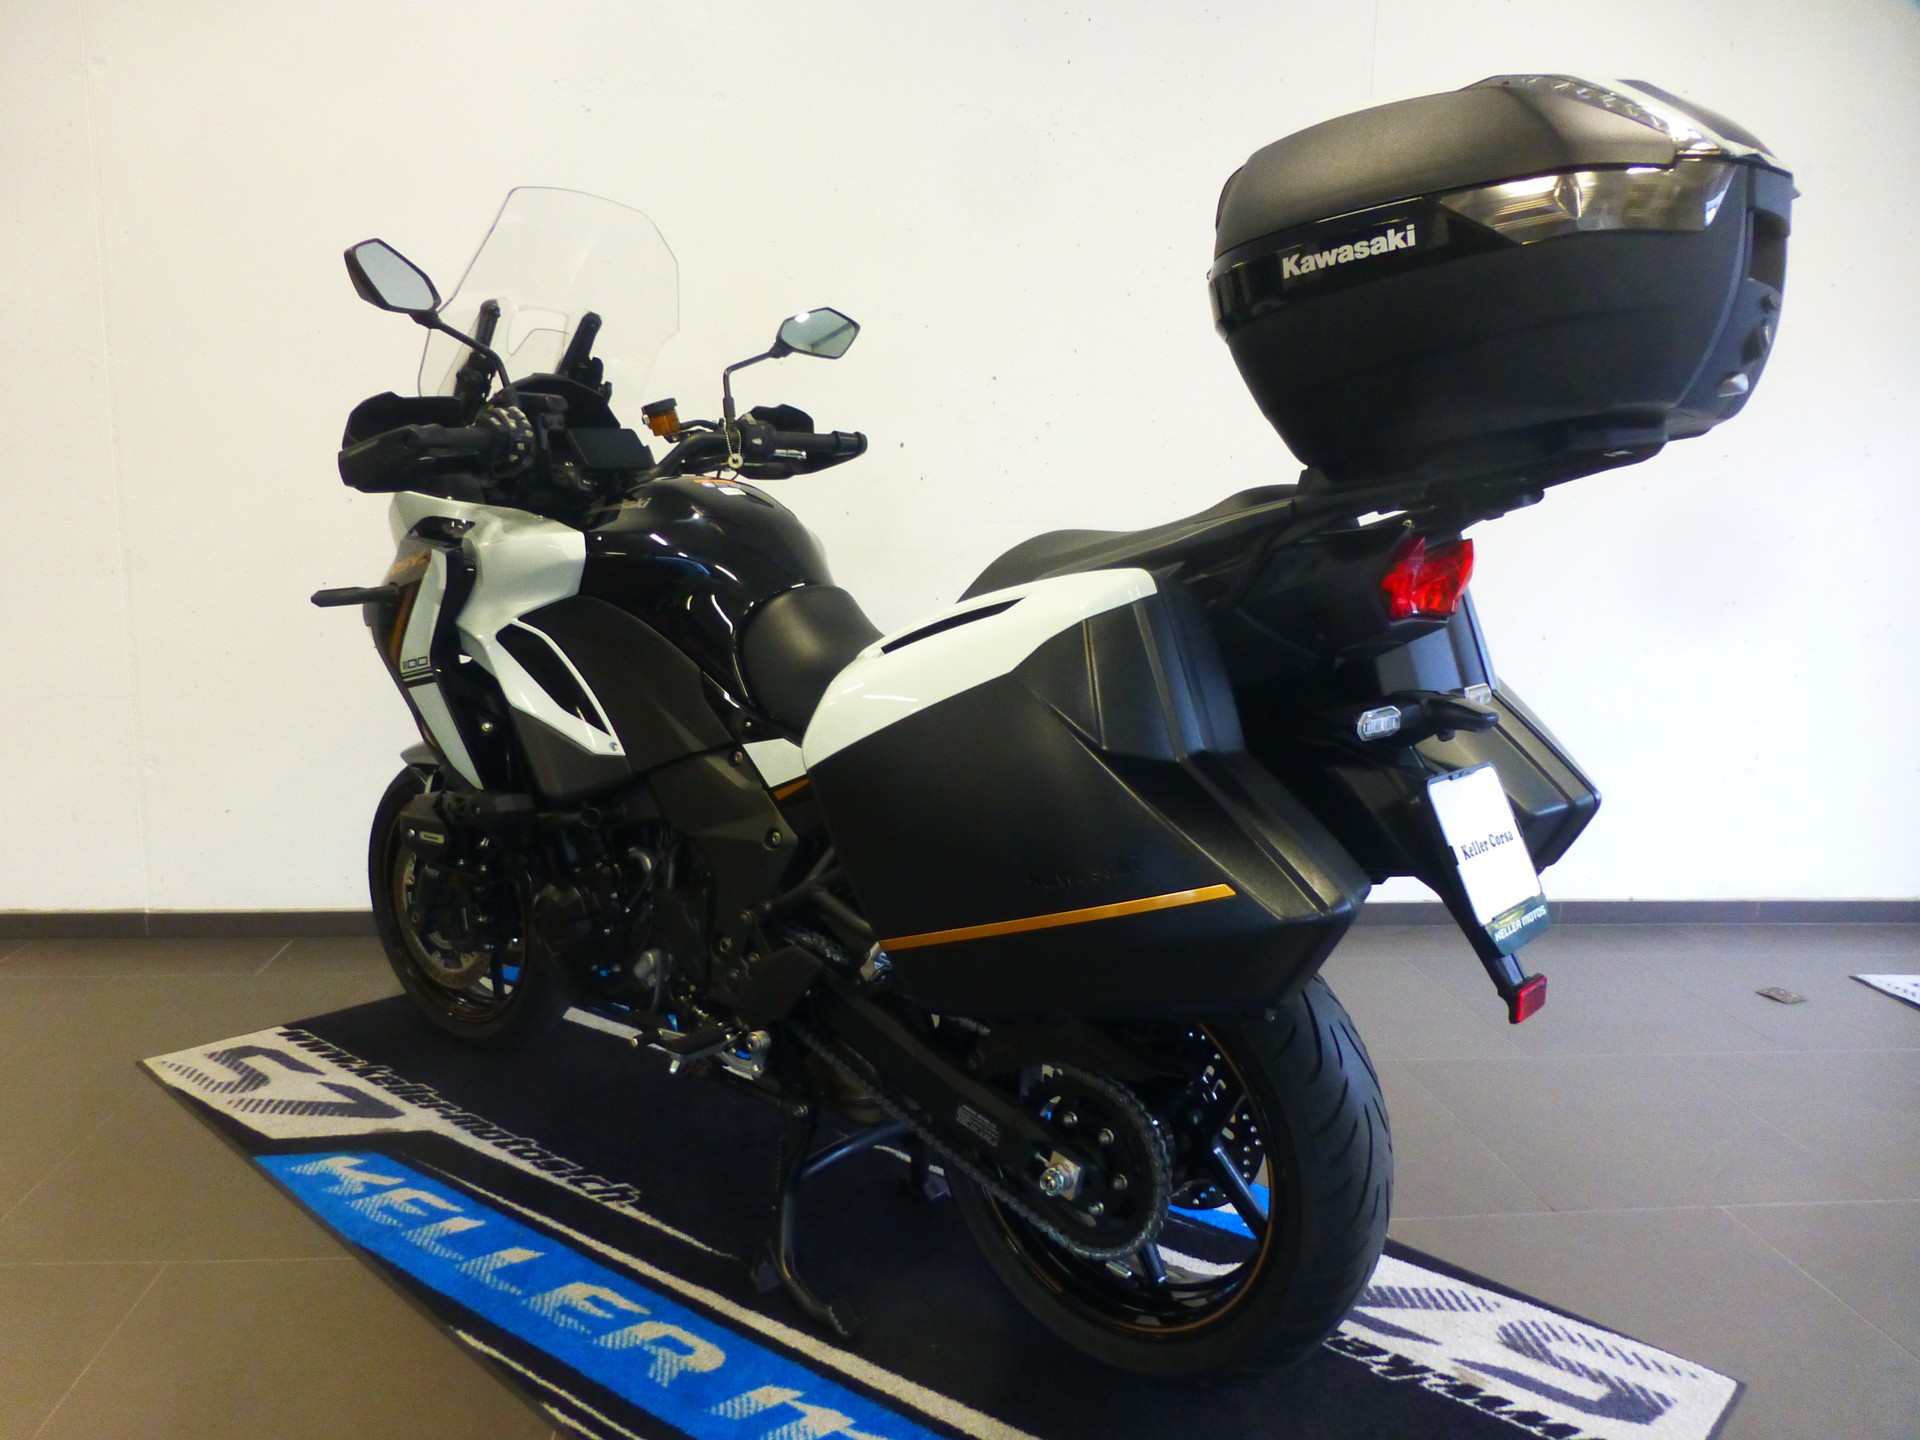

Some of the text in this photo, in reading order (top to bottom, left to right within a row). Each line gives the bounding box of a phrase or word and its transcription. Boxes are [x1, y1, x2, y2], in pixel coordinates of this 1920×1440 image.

[1282, 224, 1416, 279] Kawasaki
[1460, 830, 1514, 860] Keller Corsa
[1494, 919, 1522, 942] KELLER
[288, 1155, 726, 1388] KELLER
